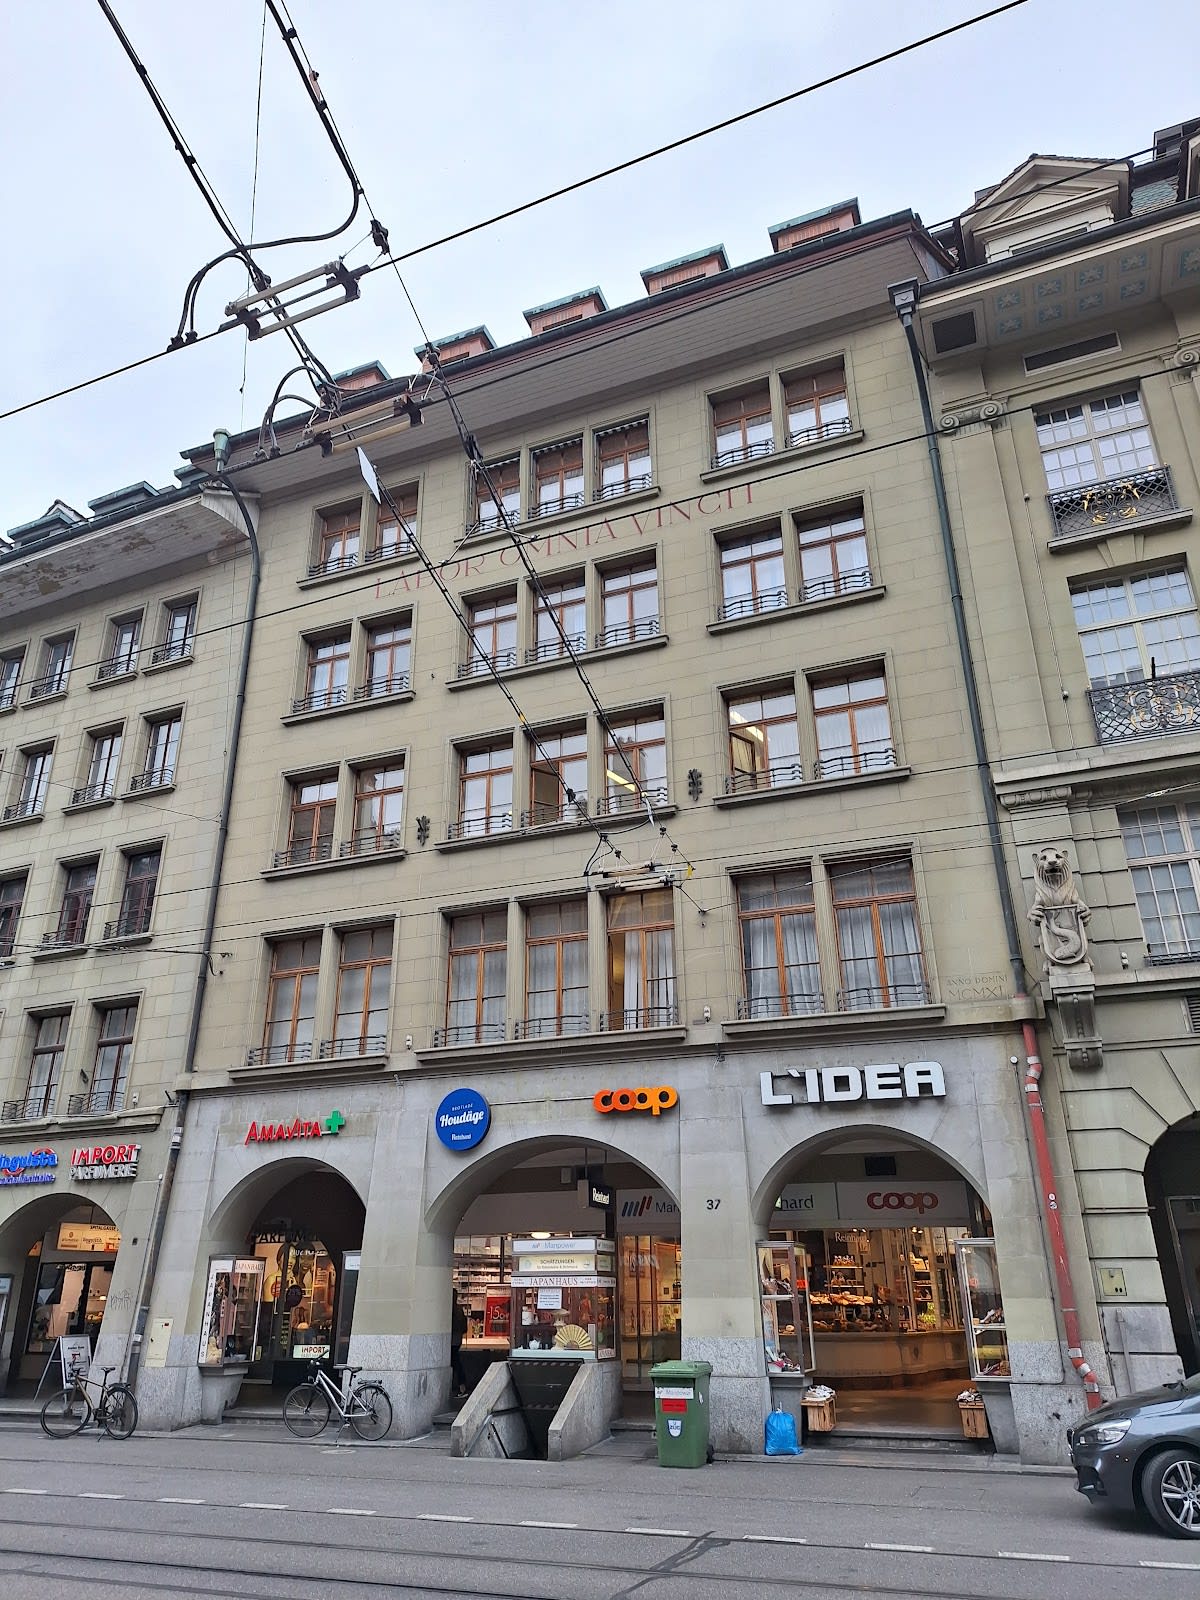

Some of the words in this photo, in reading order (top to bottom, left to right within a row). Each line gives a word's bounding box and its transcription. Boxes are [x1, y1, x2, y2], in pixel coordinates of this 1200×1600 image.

[947, 976, 971, 986] ANNO
[975, 974, 1008, 984] DOMINI
[592, 1085, 678, 1116] coop
[440, 1110, 484, 1127] Houdäge
[71, 1144, 140, 1165] IMPORT
[592, 1187, 610, 1205] Reinhard
[706, 1199, 721, 1210] 37
[866, 1192, 939, 1214] coop
[544, 1241, 576, 1249] Manpower
[529, 1277, 578, 1286] JAPANHAUS
